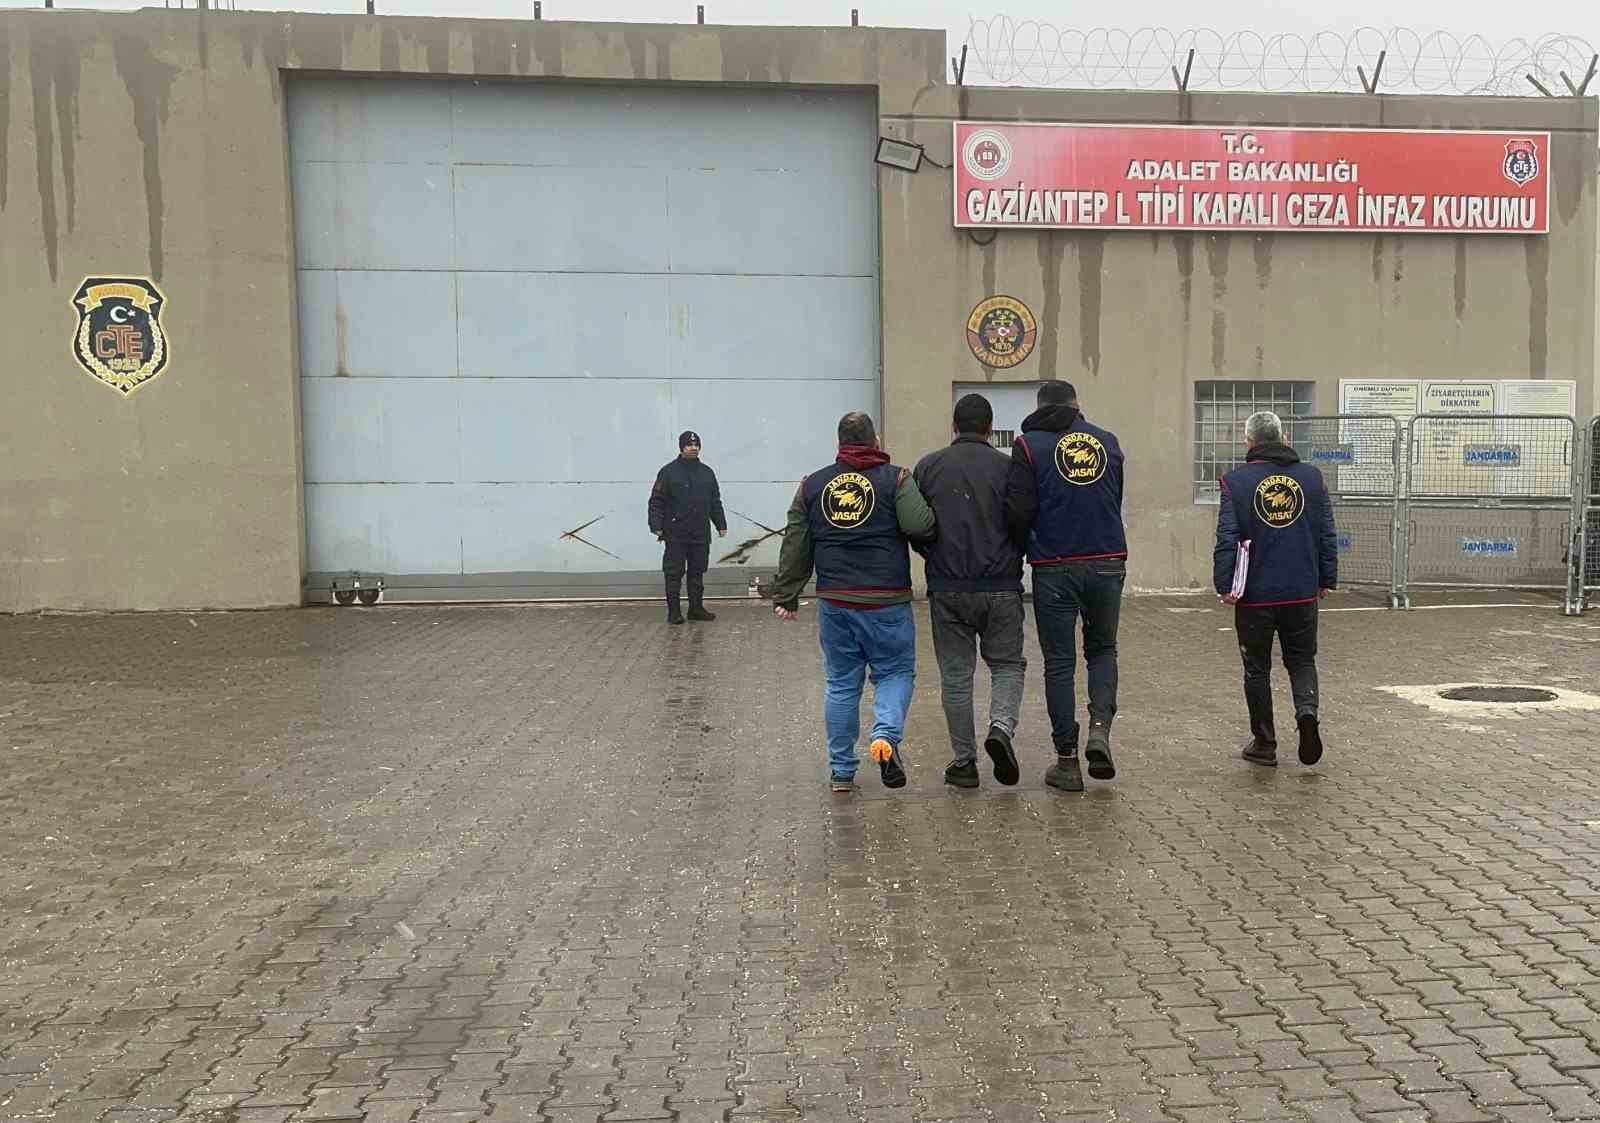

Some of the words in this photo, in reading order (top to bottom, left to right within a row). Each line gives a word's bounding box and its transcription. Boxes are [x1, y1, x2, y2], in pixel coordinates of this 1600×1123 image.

[1221, 134, 1264, 154] T.C.
[1127, 160, 1220, 181] ADALET
[1227, 159, 1358, 183] BAKANLIĞI
[967, 182, 1108, 224] GAZİANTEP
[1115, 192, 1130, 225] L
[1138, 184, 1184, 225] TİPİ
[1193, 192, 1278, 226] KAPALI
[1286, 193, 1350, 227] CEZA
[1357, 187, 1426, 228] İNFAZ
[1433, 195, 1536, 229] KURUMU
[95, 324, 144, 360] CTE
[1059, 433, 1101, 450] JANDARMA
[1465, 450, 1518, 461] JANDARMA
[1068, 468, 1096, 478] JASAT
[828, 473, 872, 493] JANDARMA
[1258, 476, 1299, 495] JANDARMA
[831, 511, 862, 521] JASAT
[1268, 511, 1294, 521] JASAT
[1462, 542, 1515, 552] JANDARMA
